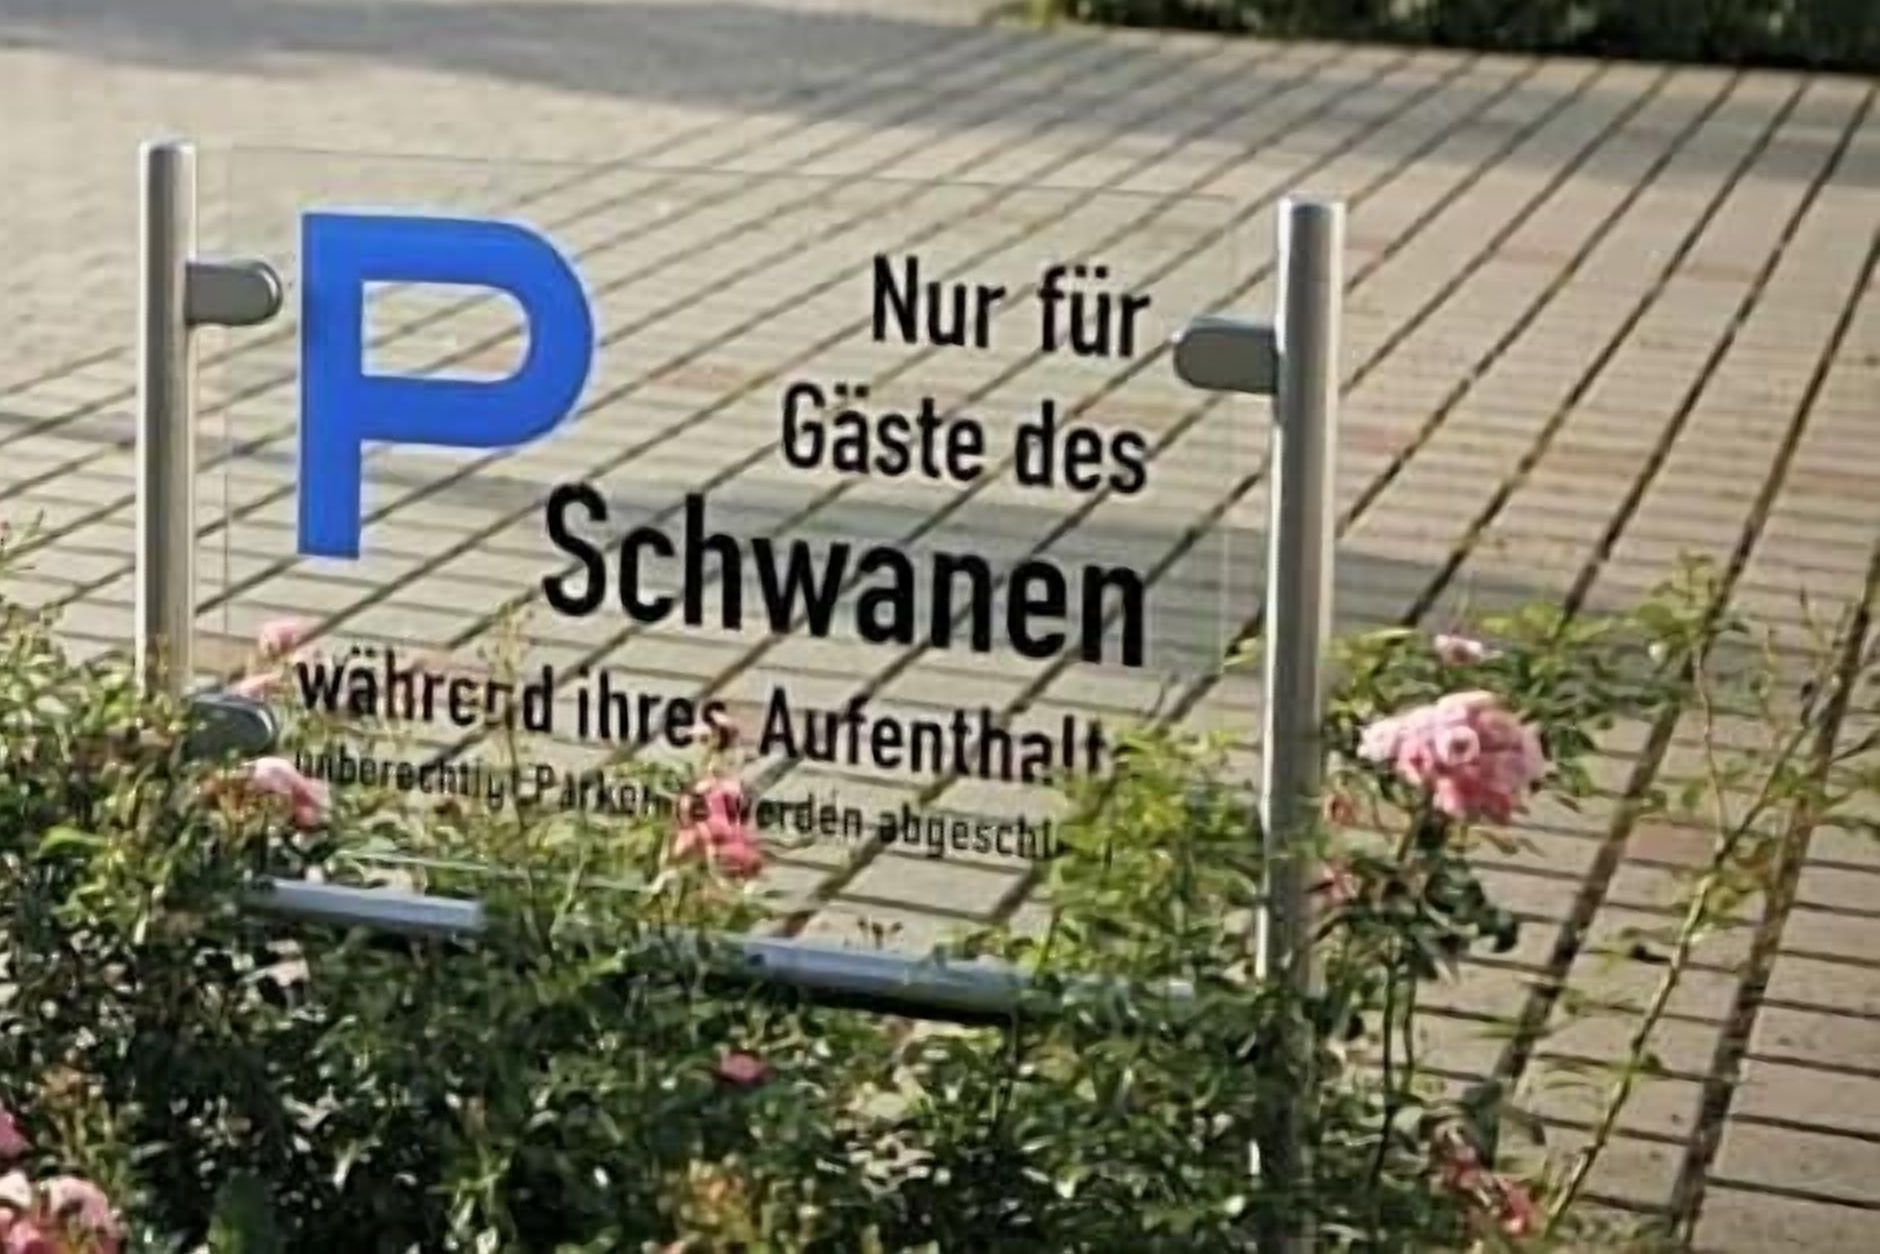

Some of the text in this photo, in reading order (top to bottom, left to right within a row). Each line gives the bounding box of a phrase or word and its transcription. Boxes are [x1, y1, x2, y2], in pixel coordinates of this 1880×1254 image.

[873, 254, 1152, 358] Nur für
[296, 211, 595, 560] P
[782, 382, 1149, 495] Gäste des
[541, 481, 1146, 668] Schwanen
[296, 644, 1134, 788] während ihres Aufenthalt
[723, 791, 863, 838] werden
[878, 801, 1060, 859] abgeschl
